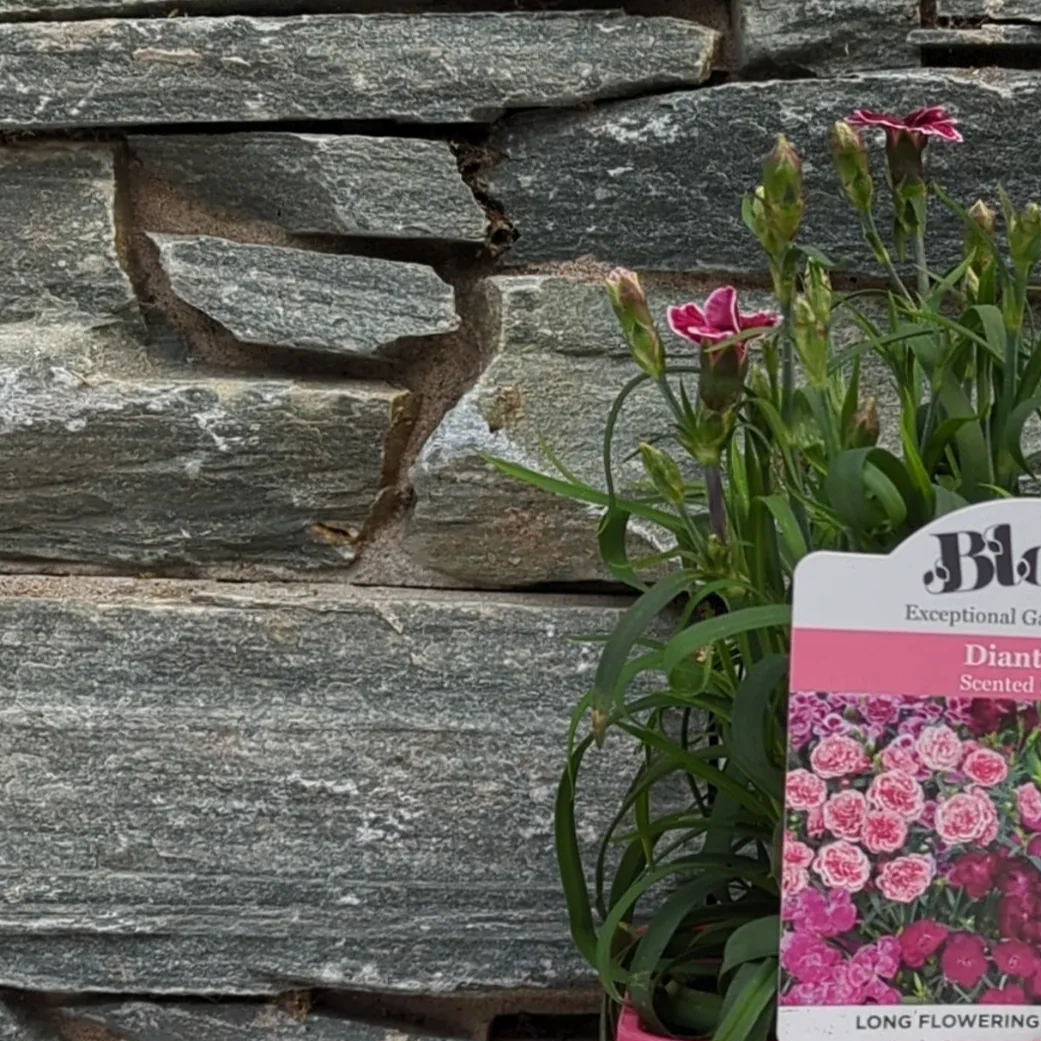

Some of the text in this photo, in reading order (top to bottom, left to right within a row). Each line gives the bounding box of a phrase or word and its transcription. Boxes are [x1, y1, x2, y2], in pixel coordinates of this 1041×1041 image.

[905, 604, 1016, 627] Exceptional
[960, 674, 1034, 694] Scented
[856, 1014, 911, 1030] LONG
[919, 1013, 1039, 1029] FLOWERING
